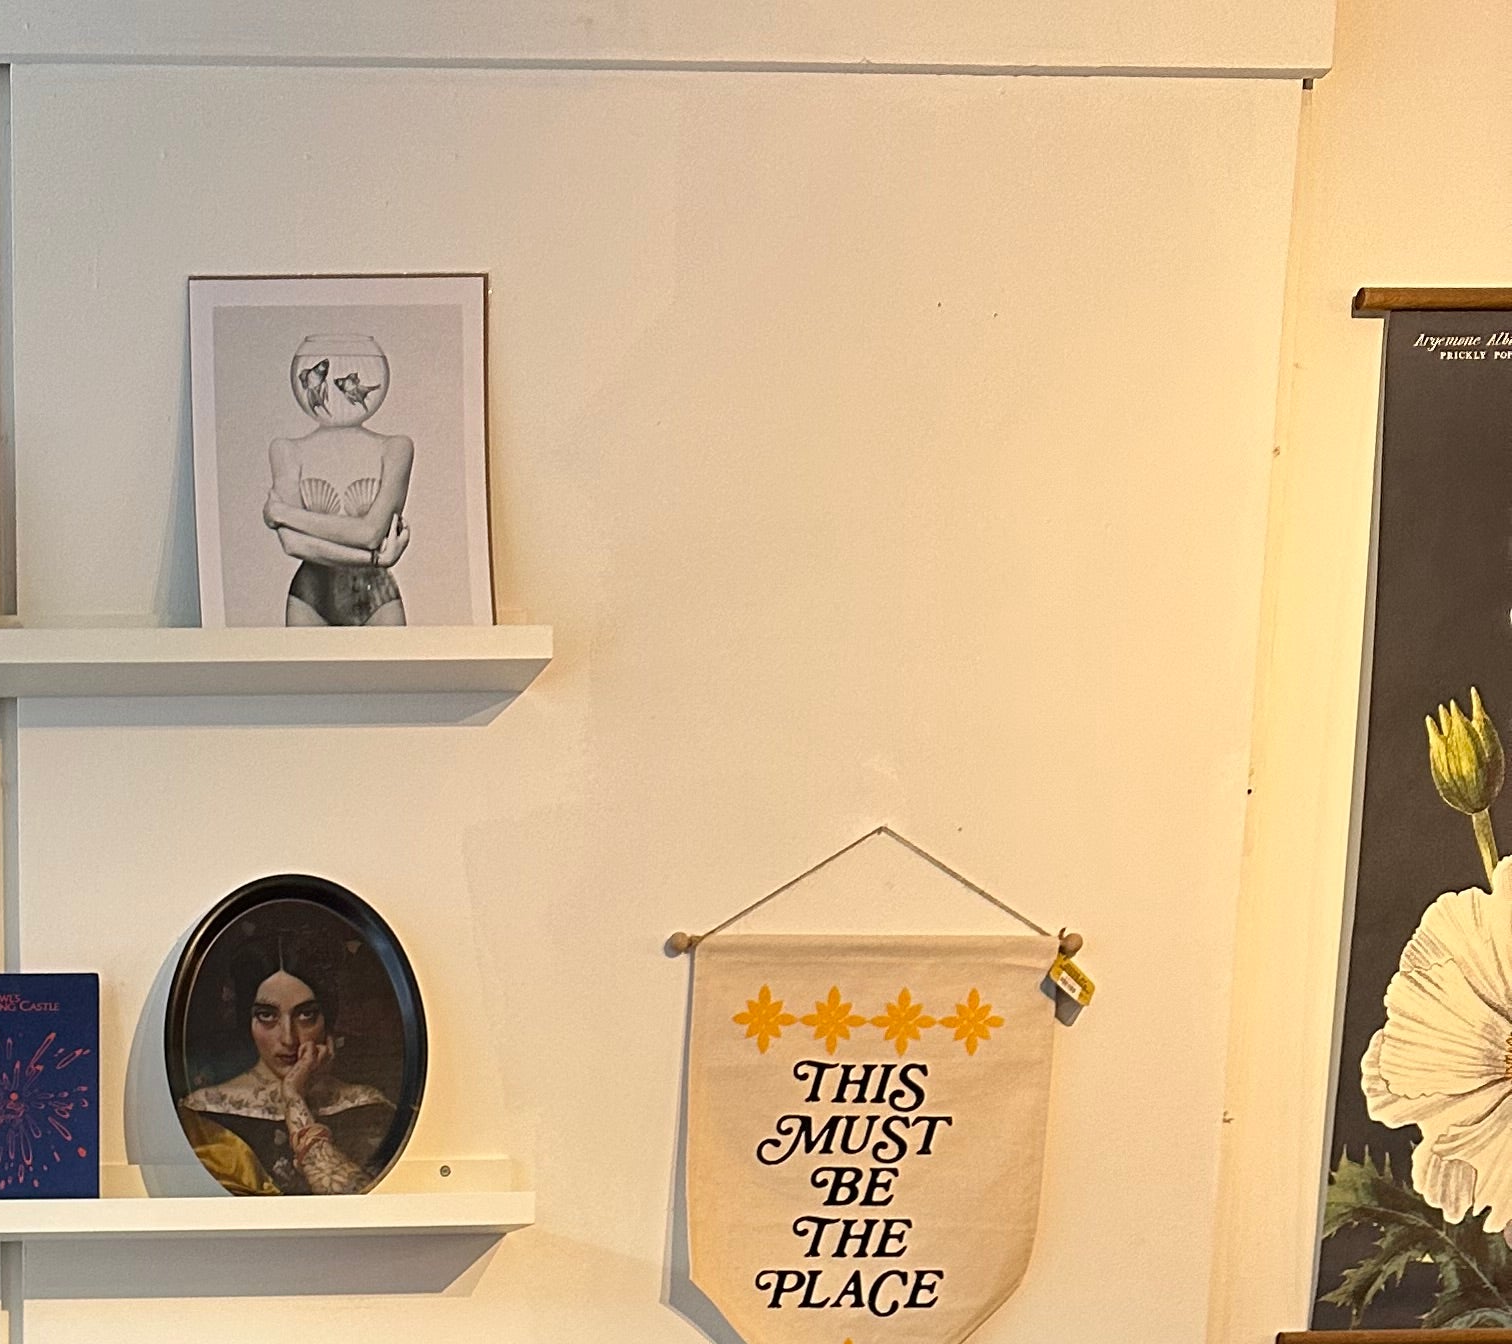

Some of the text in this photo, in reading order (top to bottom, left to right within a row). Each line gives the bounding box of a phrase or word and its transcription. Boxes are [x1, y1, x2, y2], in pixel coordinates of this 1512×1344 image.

[1413, 333, 1482, 352] Argemone
[1439, 351, 1487, 360] PRICKLY
[19, 1000, 61, 1013] CASTLE
[793, 1060, 929, 1112] THIS
[756, 1114, 953, 1166] MUST
[810, 1166, 900, 1206] BE
[792, 1215, 913, 1258] THE
[754, 1269, 945, 1318] PLACE
